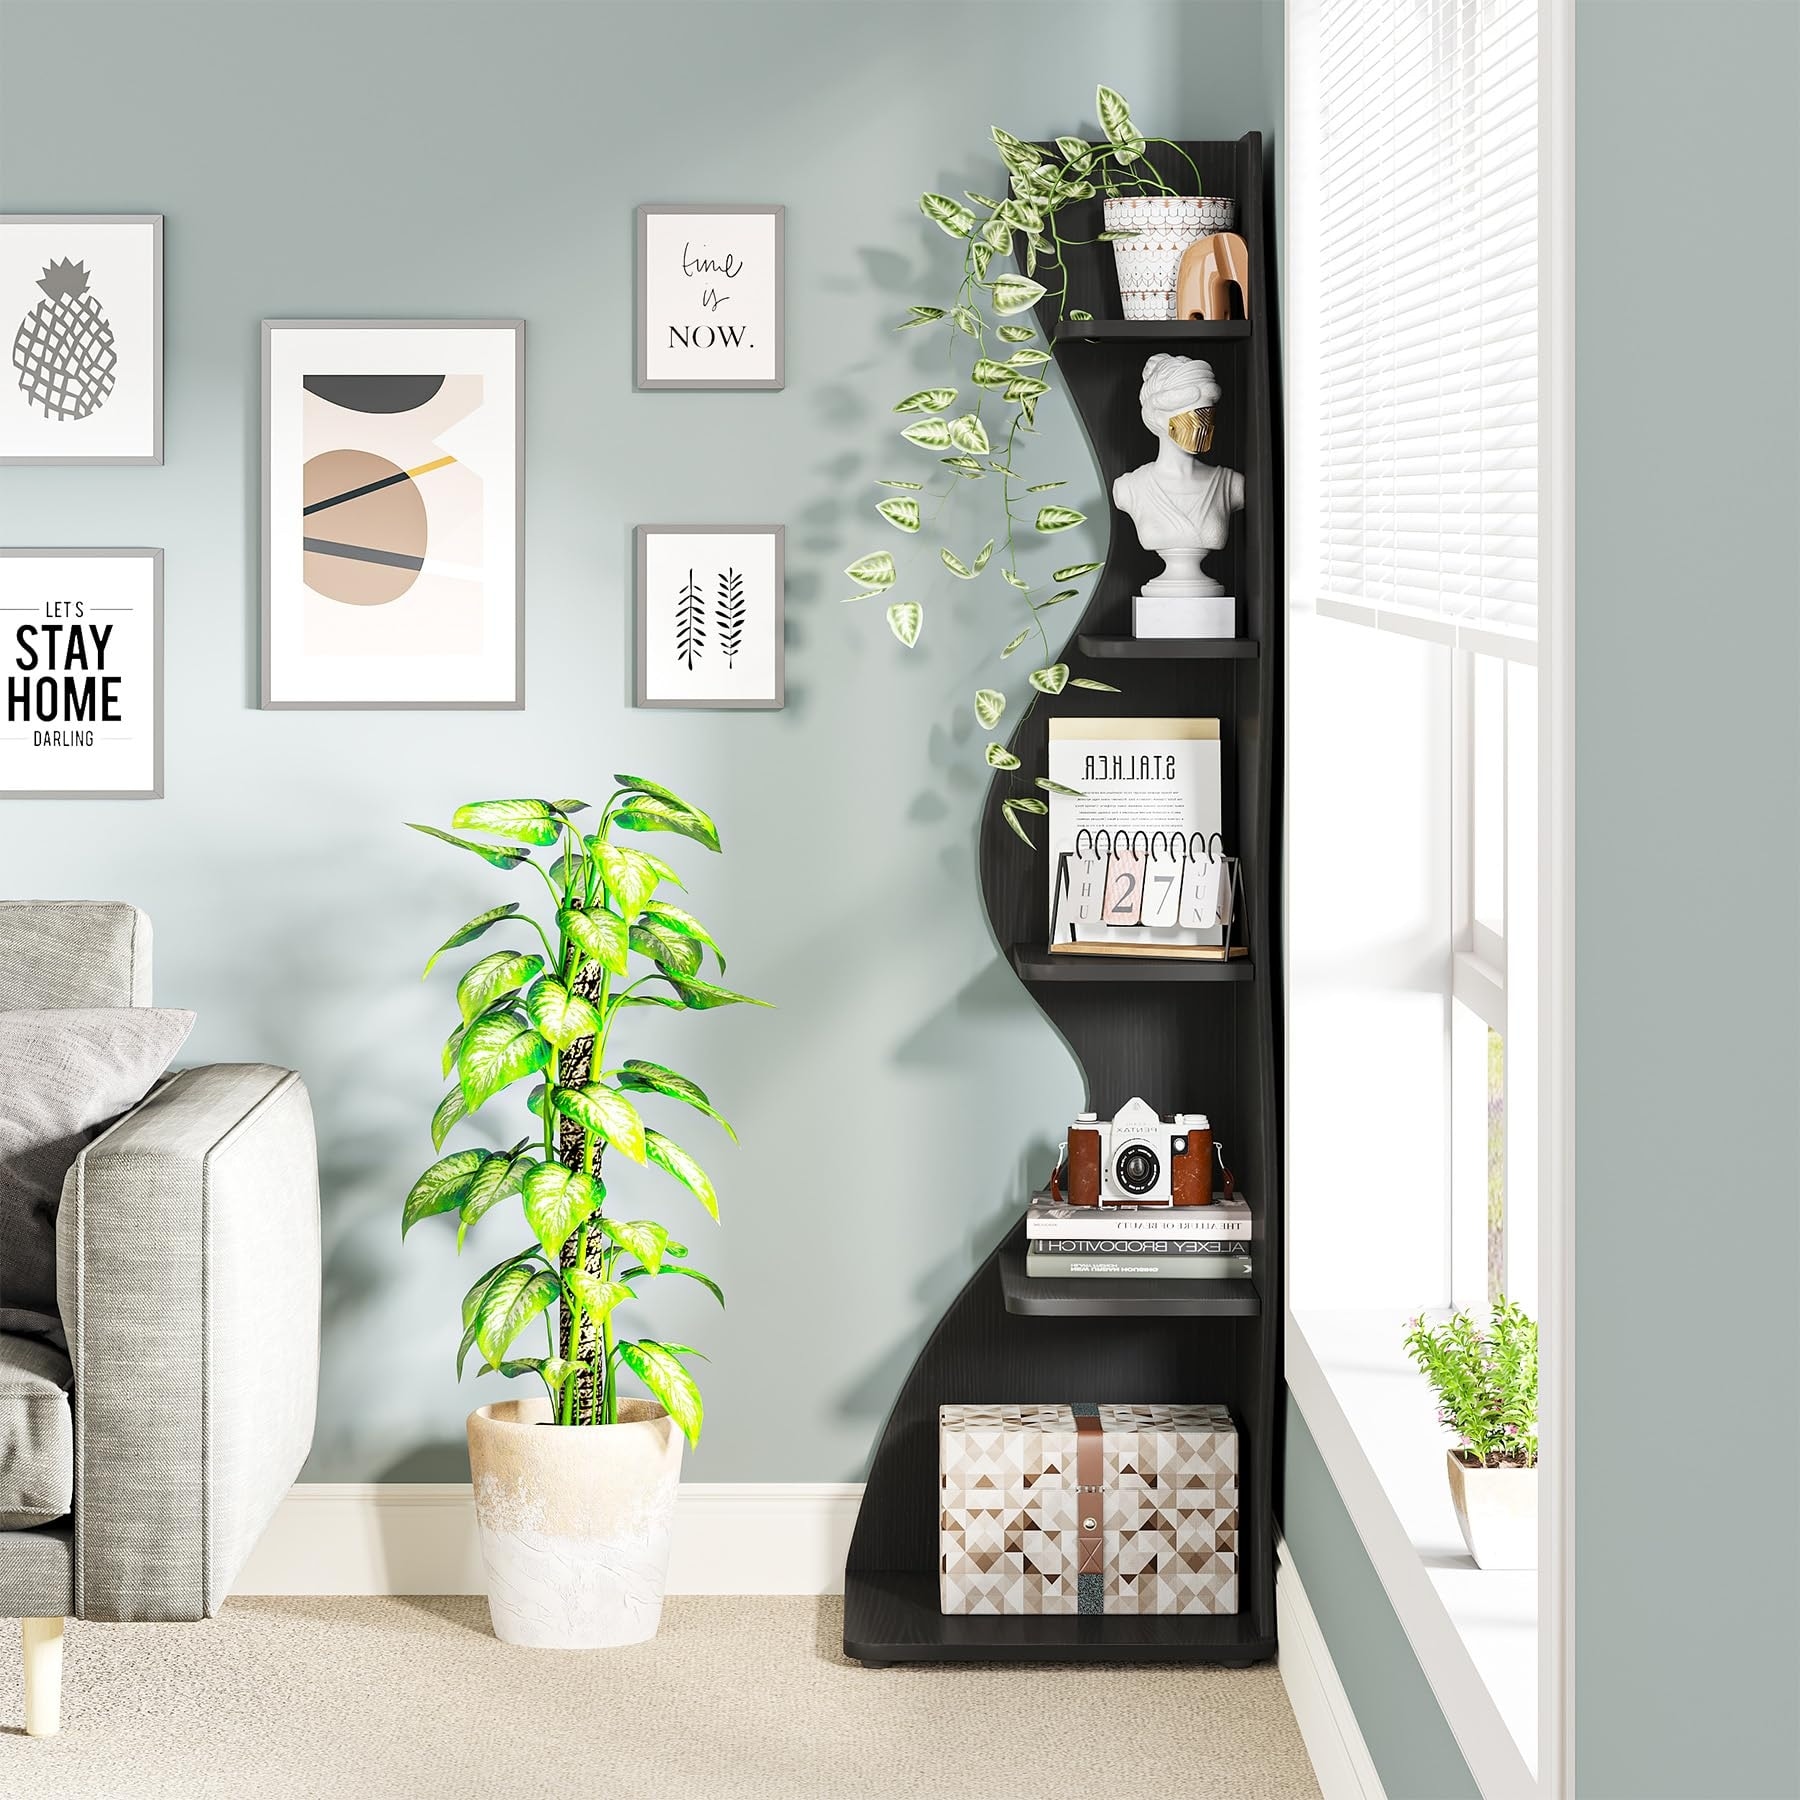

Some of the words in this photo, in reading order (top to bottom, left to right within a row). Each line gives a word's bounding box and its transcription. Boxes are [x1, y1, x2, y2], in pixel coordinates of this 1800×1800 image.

[681, 241, 743, 278] time
[702, 282, 730, 312] is
[668, 325, 754, 349] NOW.
[16, 624, 114, 671] STAY
[8, 676, 122, 722] HOME
[34, 730, 94, 747] DARLING
[1079, 859, 1095, 920] THU
[1192, 862, 1208, 924] JUN
